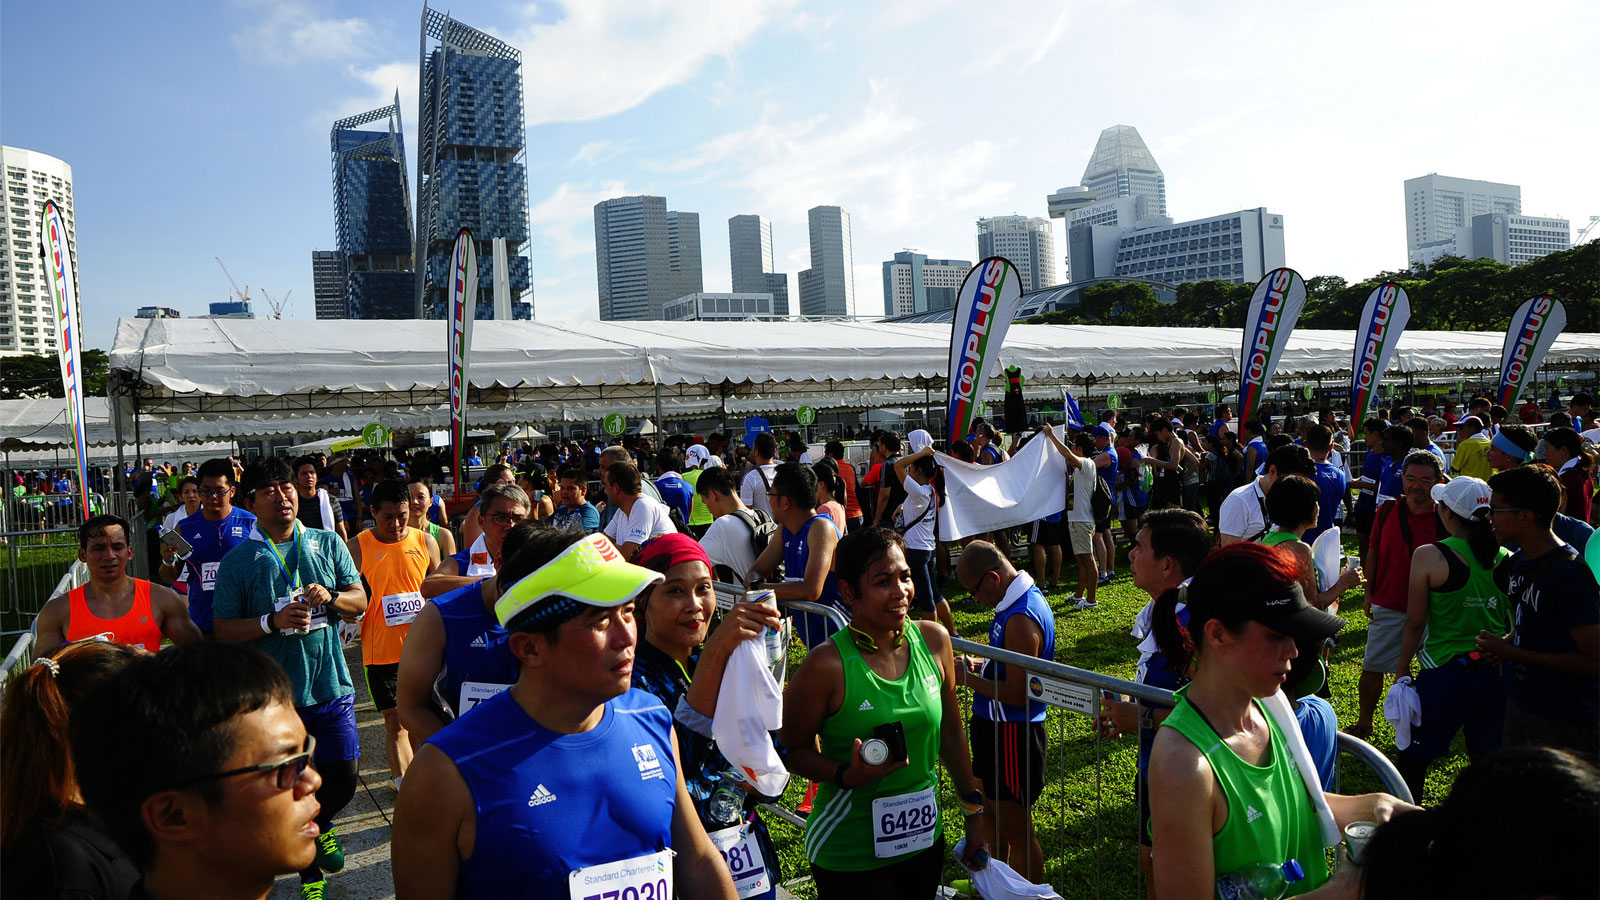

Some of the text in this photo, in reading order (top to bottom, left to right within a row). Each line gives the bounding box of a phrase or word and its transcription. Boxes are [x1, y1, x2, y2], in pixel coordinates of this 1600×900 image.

[1079, 202, 1116, 218] PAN PACIFIC
[1510, 217, 1569, 229] MANDARIN ORIENTAL
[46, 212, 79, 426] 100PLUS
[452, 233, 468, 423] 100PLUS
[1245, 269, 1291, 386] 100PLUS
[954, 259, 1005, 403] 100PLUS
[1356, 285, 1397, 392] 100PLUS
[1503, 297, 1552, 388] 100PLUS
[387, 599, 422, 615] 63209
[471, 686, 495, 694] Standard
[528, 794, 557, 807] adidas
[883, 793, 932, 808] Standard Chartered
[712, 833, 737, 844] Chartered
[584, 864, 656, 886] Standard Chartered
